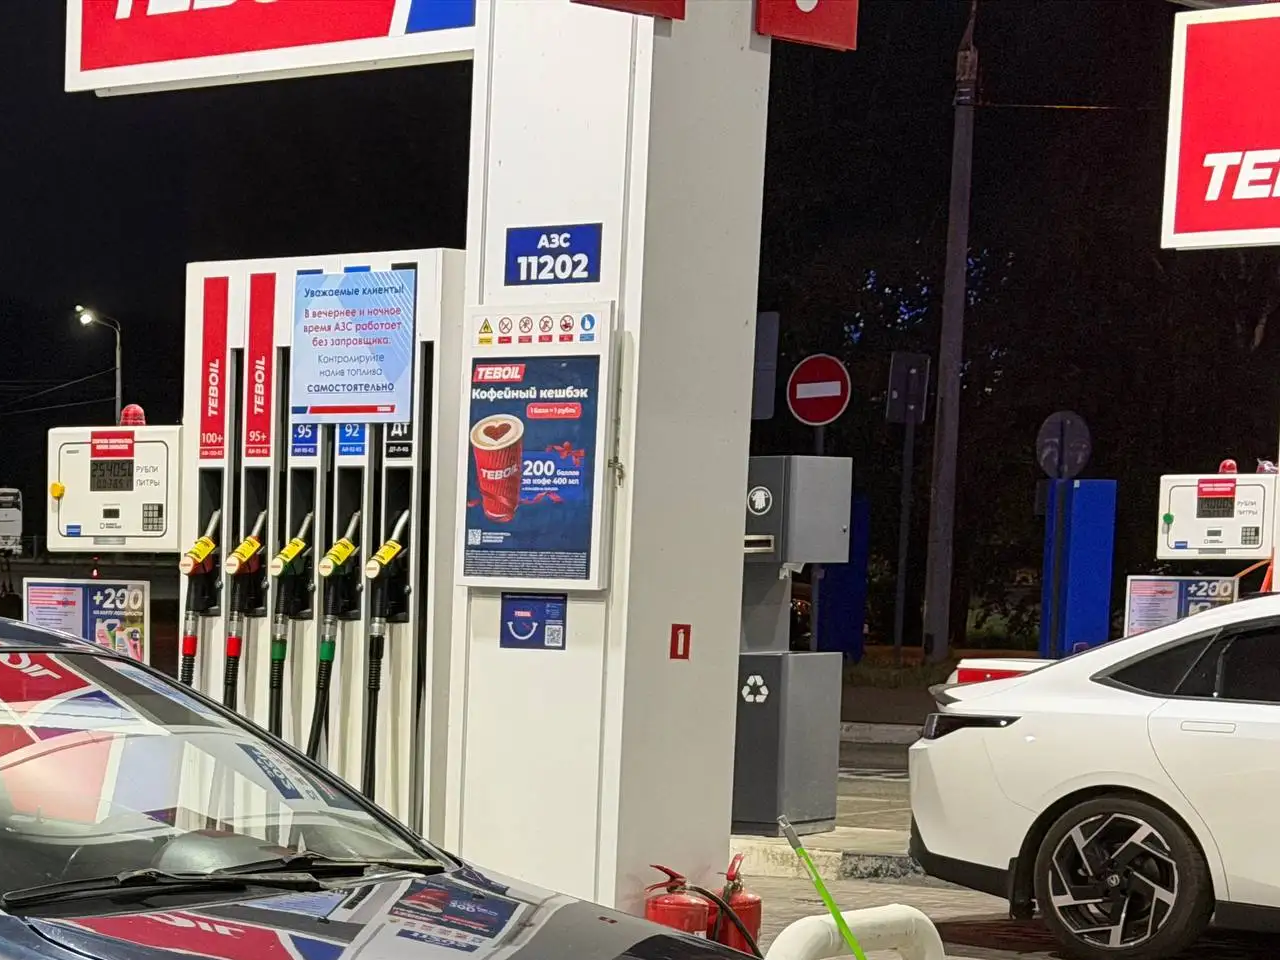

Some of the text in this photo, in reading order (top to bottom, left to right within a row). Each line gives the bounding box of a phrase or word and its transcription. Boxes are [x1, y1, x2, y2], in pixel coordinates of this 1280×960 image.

[1203, 148, 1280, 201] TE
[537, 233, 571, 249] АЗС
[517, 253, 589, 281] 11202
[304, 284, 404, 297] Уважаемые клиенты!
[304, 309, 309, 318] В
[312, 308, 357, 319] вечернее
[368, 307, 401, 316] ночное
[303, 321, 402, 334] время АЗС работает
[312, 336, 391, 348] без заправщика.
[318, 353, 384, 365] Контролируйте
[320, 367, 382, 377] налив топлива
[477, 366, 521, 380] TEBOIL
[208, 358, 219, 417] TEBOIL
[254, 355, 265, 415] TEBOIL
[307, 382, 394, 392] самостоятельно
[472, 386, 588, 402] Кофейный кешбэк
[249, 430, 267, 442] 95+
[345, 424, 359, 437] 92
[201, 432, 223, 444] 100+
[135, 465, 159, 473] РУБЛИ
[523, 460, 555, 476] 200
[533, 477, 552, 486] кофе
[1187, 581, 1233, 597] +200
[93, 588, 143, 609] +200
